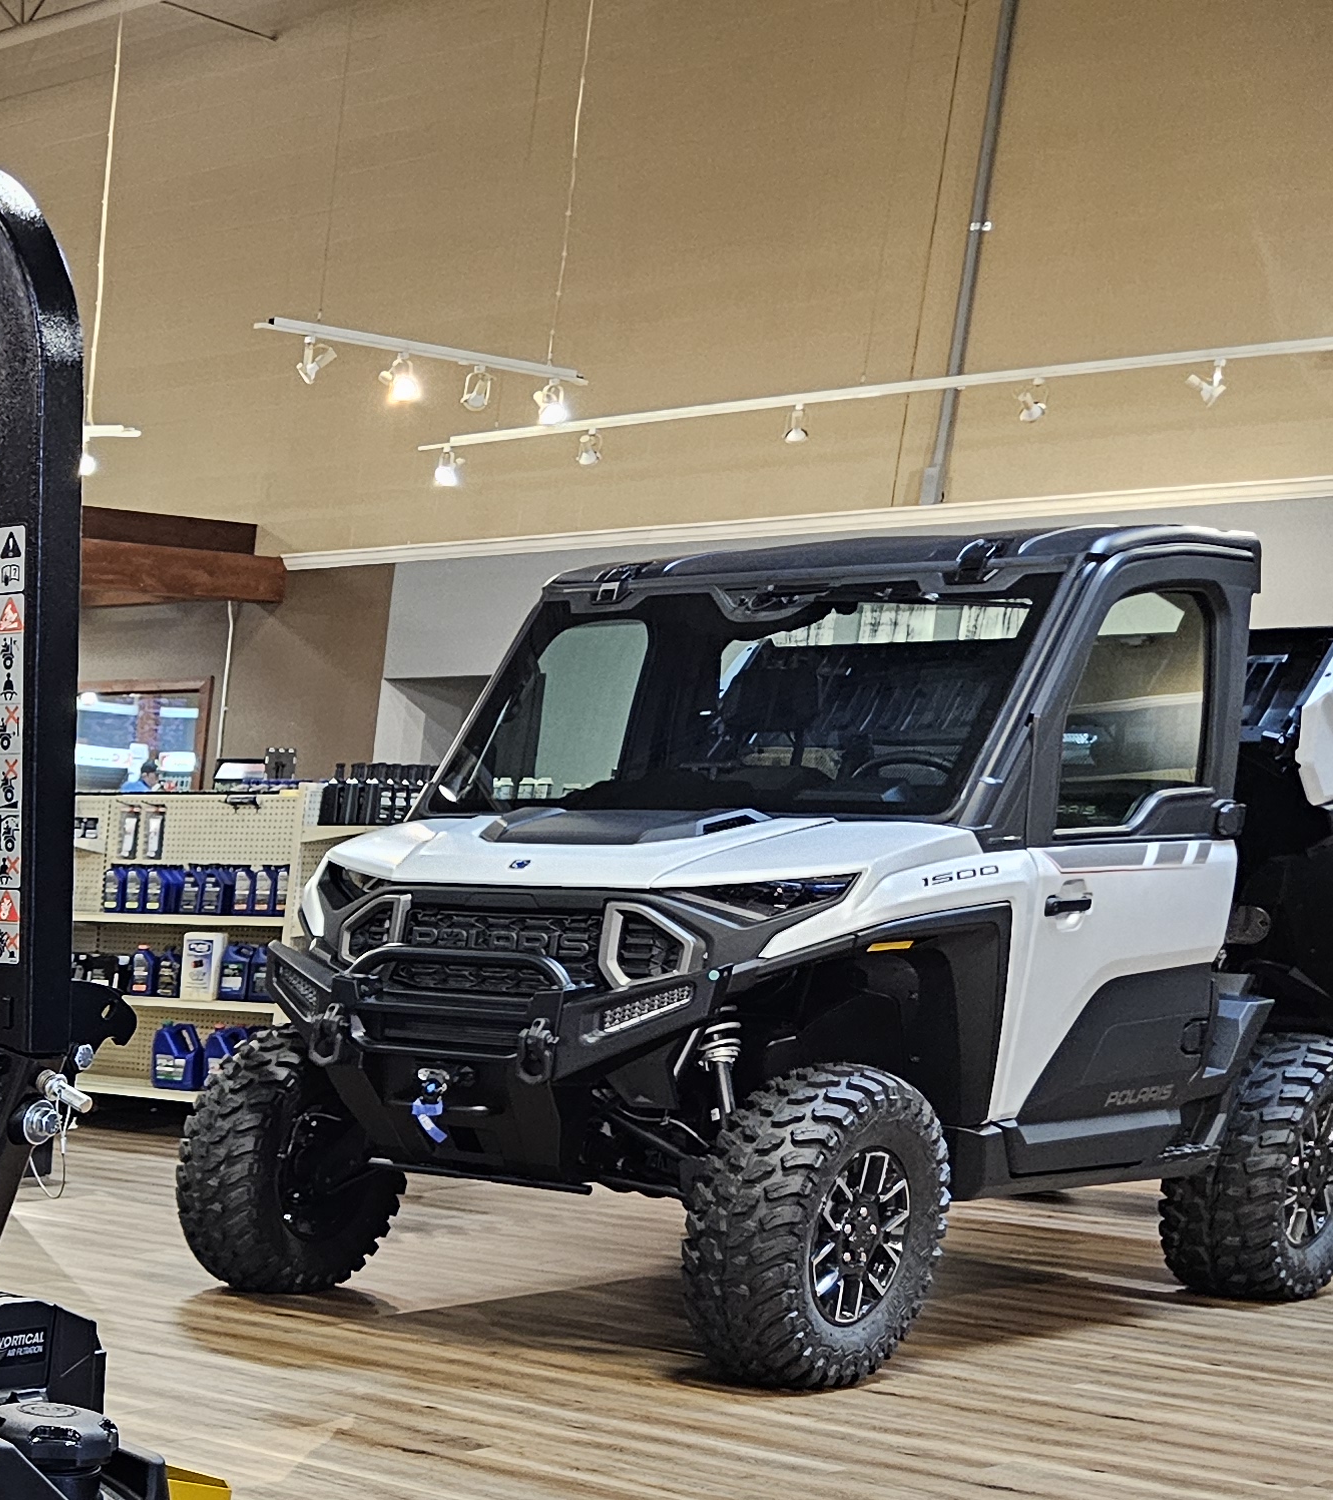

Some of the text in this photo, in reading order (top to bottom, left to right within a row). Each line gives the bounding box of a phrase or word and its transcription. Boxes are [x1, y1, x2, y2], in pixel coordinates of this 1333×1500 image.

[921, 865, 999, 887] 1500
[412, 926, 589, 957] POLARIS
[1103, 1084, 1175, 1107] POLARIS
